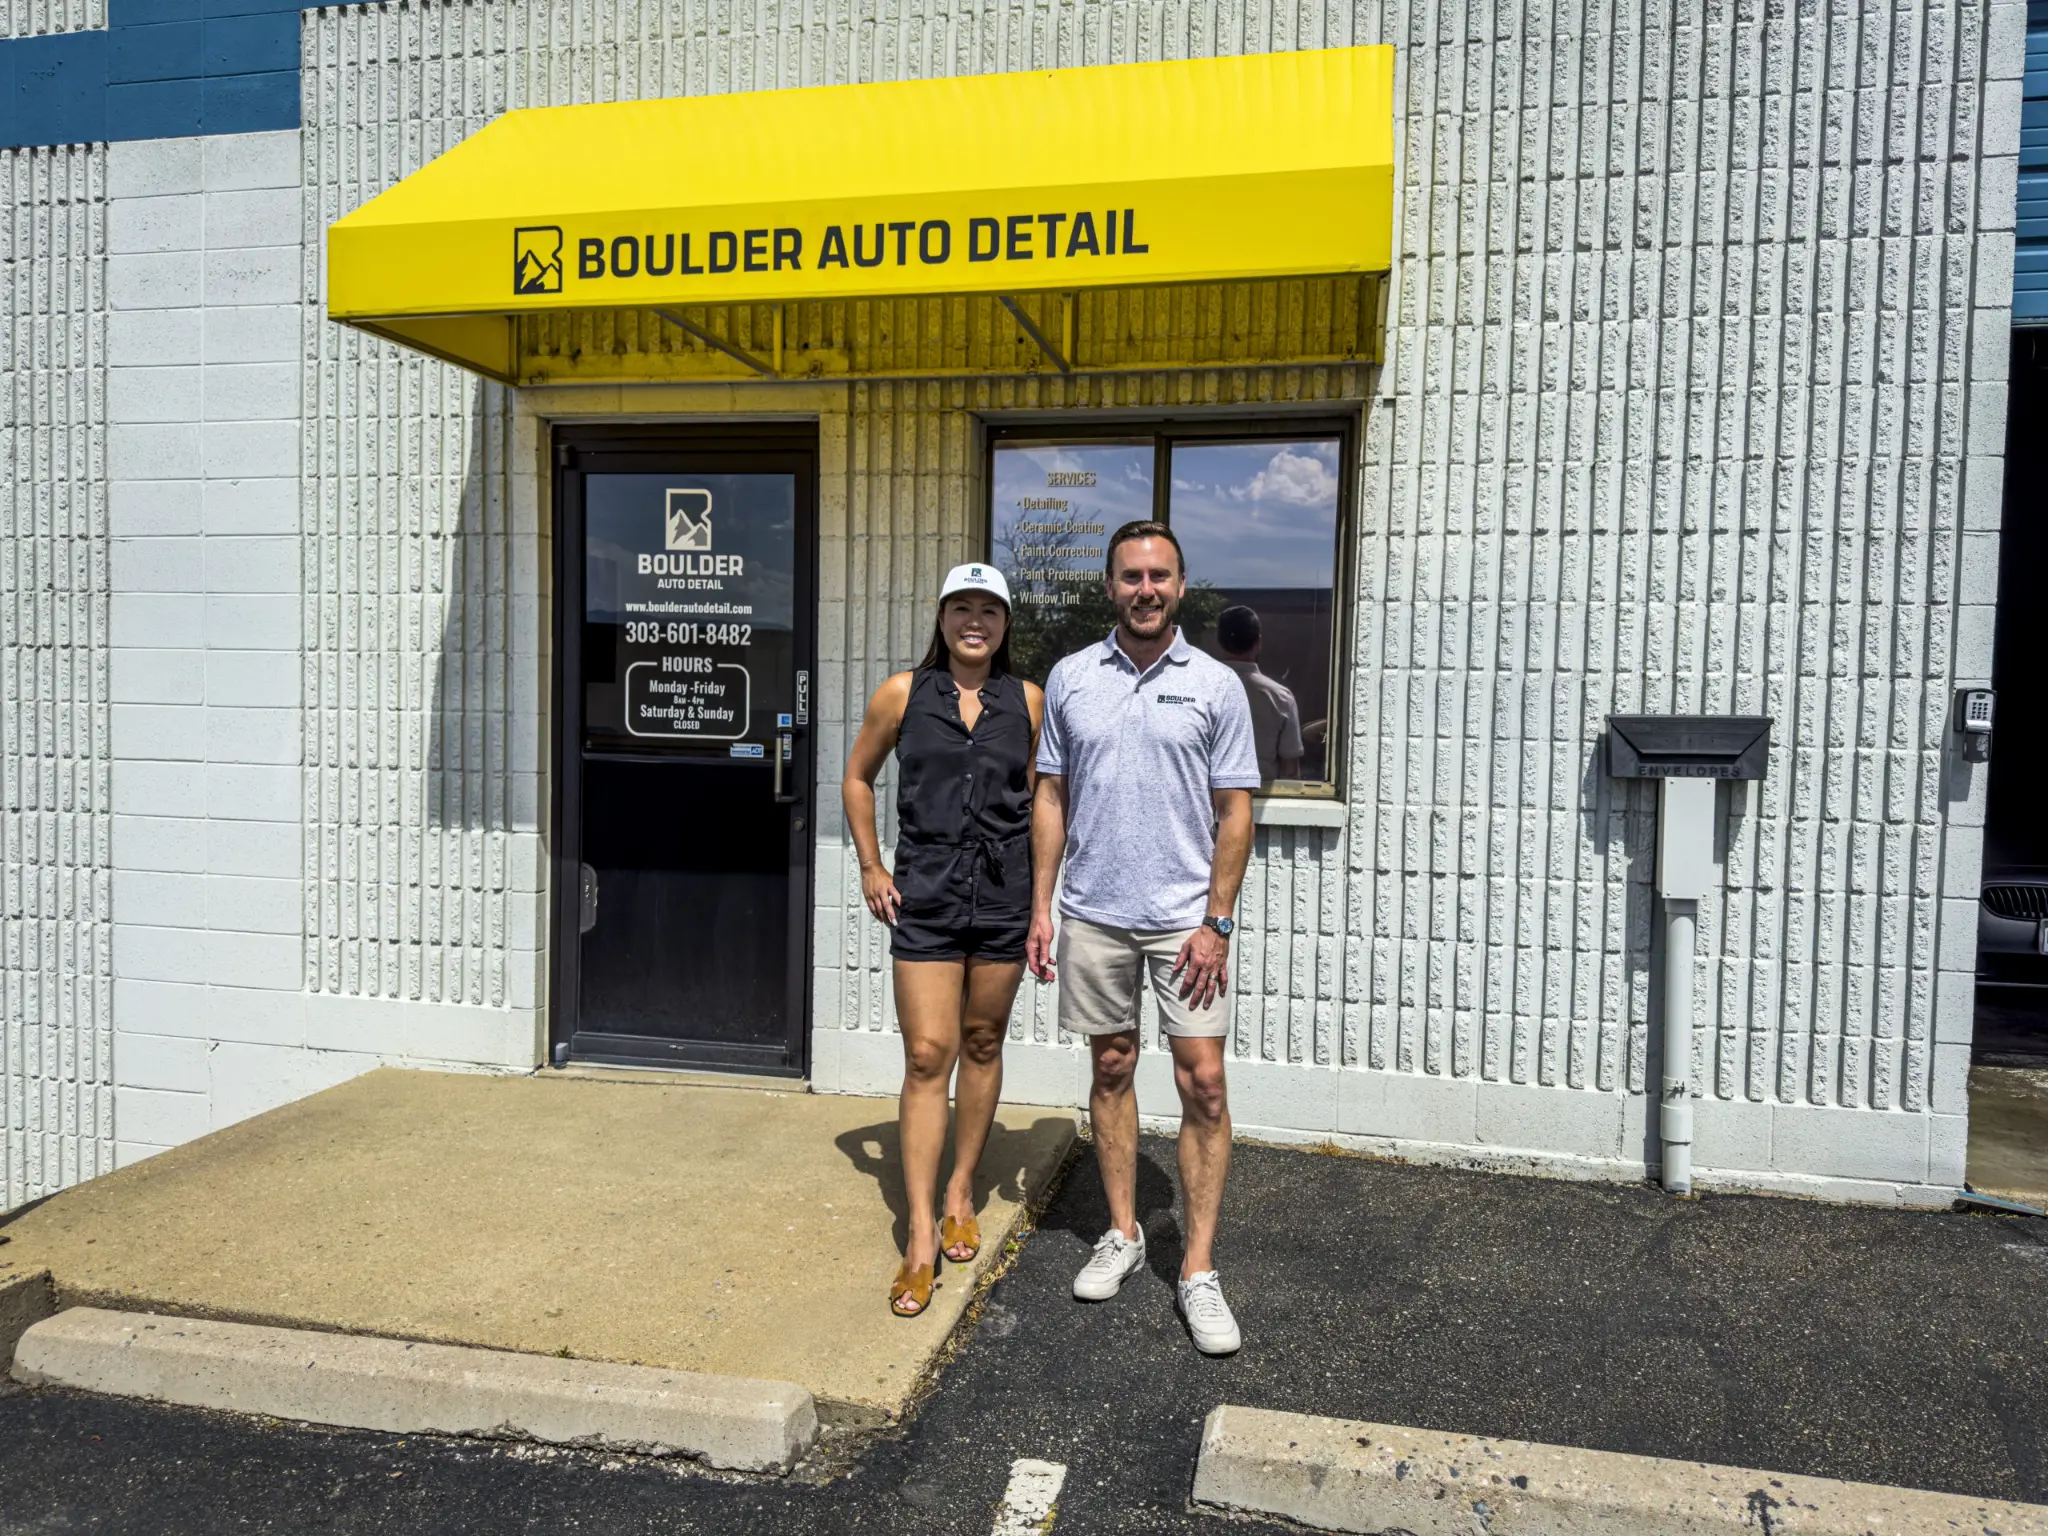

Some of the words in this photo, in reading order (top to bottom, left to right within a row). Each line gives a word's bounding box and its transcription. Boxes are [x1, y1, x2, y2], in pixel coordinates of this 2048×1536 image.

[578, 227, 803, 280] BOULDER
[817, 219, 951, 270] AUTO
[967, 208, 1149, 263] DETAIL
[1047, 472, 1096, 487] SERVICES
[1023, 497, 1068, 512] Detailing
[1022, 520, 1062, 534] Ceramic
[1065, 520, 1105, 536] Coating
[1021, 545, 1046, 557] Paint
[1049, 544, 1102, 557] Correction
[638, 554, 743, 576] BOULDER
[1020, 568, 1045, 580] Paint
[1048, 568, 1100, 581] Protection
[657, 578, 686, 589] AUTO
[687, 579, 724, 590] DETAIL
[1020, 592, 1058, 604] Window
[1060, 591, 1080, 604] Tint
[625, 601, 753, 615] www.boulderautodetail.com
[625, 621, 752, 646] 303-601-8482
[662, 656, 713, 673] HOURS
[649, 680, 688, 695] Monday
[799, 675, 807, 712] PULL
[640, 704, 685, 720] Saturday
[687, 706, 695, 718] &
[697, 706, 734, 722] Sunday
[673, 720, 700, 730] CLOSED
[1639, 765, 1741, 778] ENVELOPES
